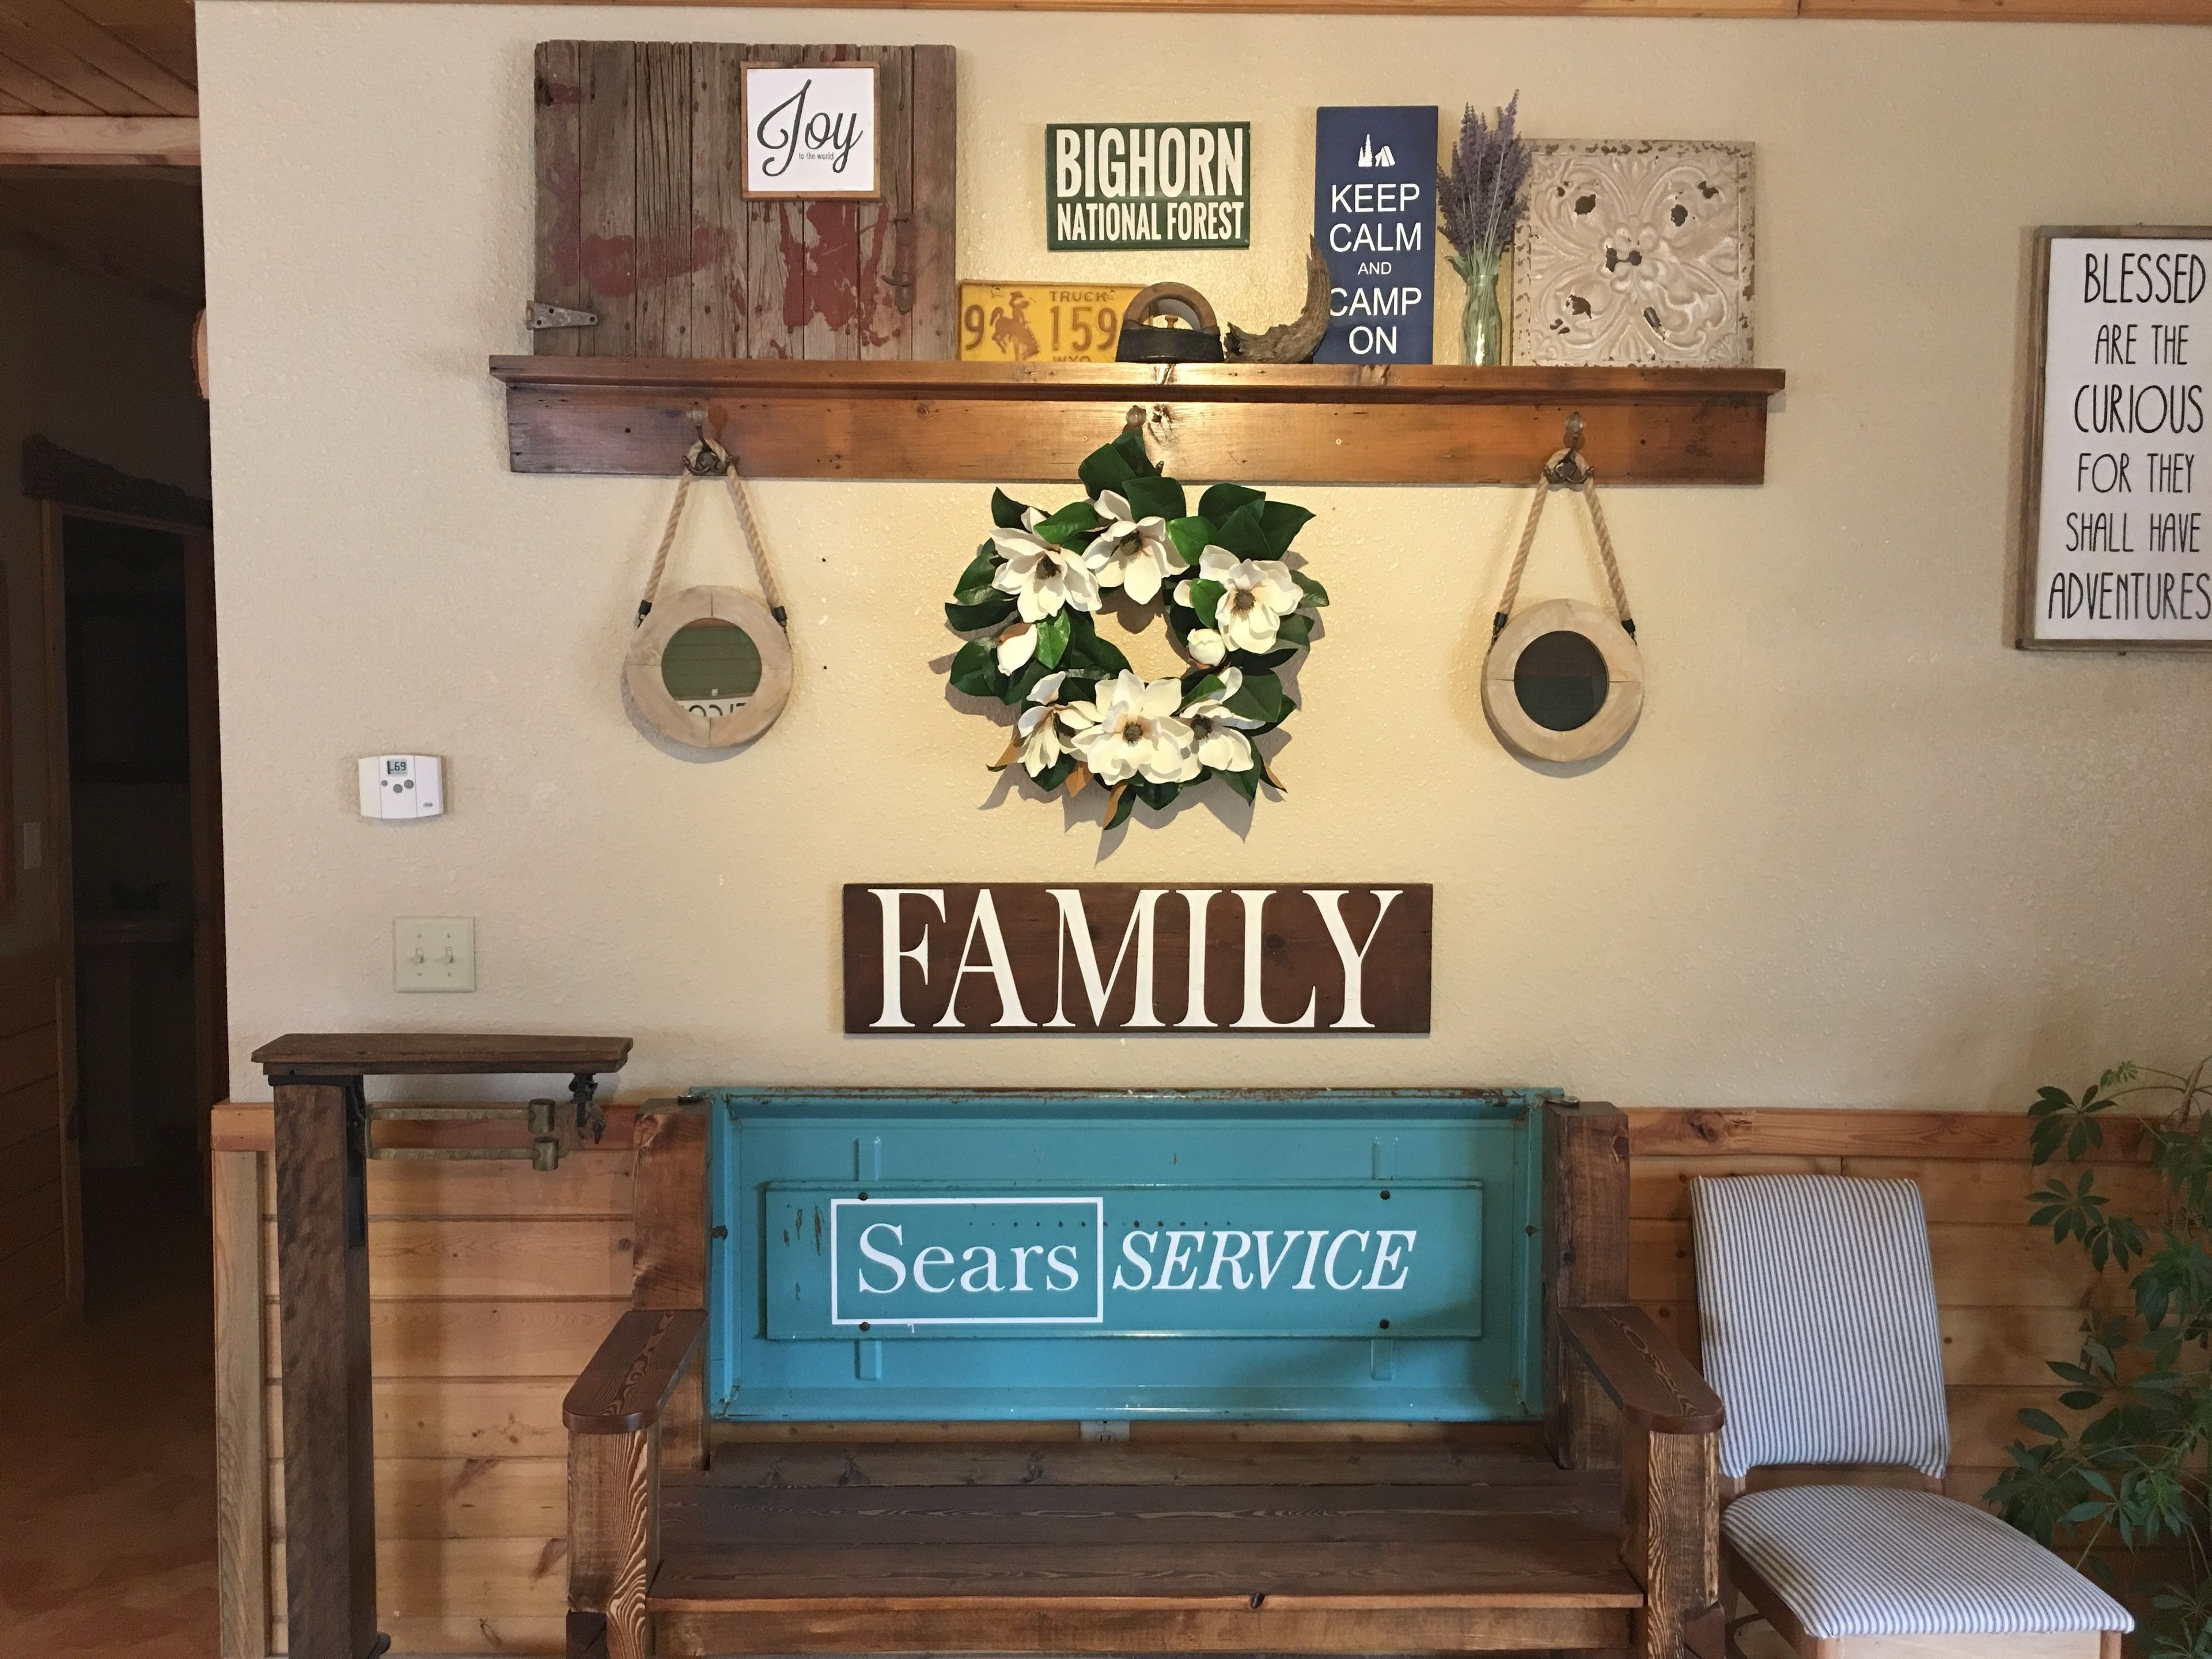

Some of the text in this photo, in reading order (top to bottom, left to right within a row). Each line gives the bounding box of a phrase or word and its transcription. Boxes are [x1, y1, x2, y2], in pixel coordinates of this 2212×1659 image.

[756, 78, 863, 177] Joy
[798, 151, 834, 160] to the world
[1056, 127, 1243, 198] BIGHORN
[1331, 183, 1421, 213] KEEP
[1057, 201, 1244, 241] NATIONAL FOREST
[1329, 222, 1422, 252] CALM
[1357, 261, 1392, 275] AND
[2084, 253, 2206, 304] BLESSED
[1050, 291, 1108, 302] TRUCK
[1330, 287, 1422, 317] CAMP
[964, 304, 1118, 352] 9 159
[1349, 325, 1397, 355] ON
[2094, 324, 2189, 365] ARE THE
[2074, 384, 2204, 434] CURIOUS
[2078, 453, 2194, 494] FOR THEY
[2066, 512, 2202, 553] SHALL HAVE
[2048, 572, 2211, 620] ADVENTURES
[868, 888, 1404, 1028] FAMILY
[858, 1223, 1417, 1294] Sears SERVICE
